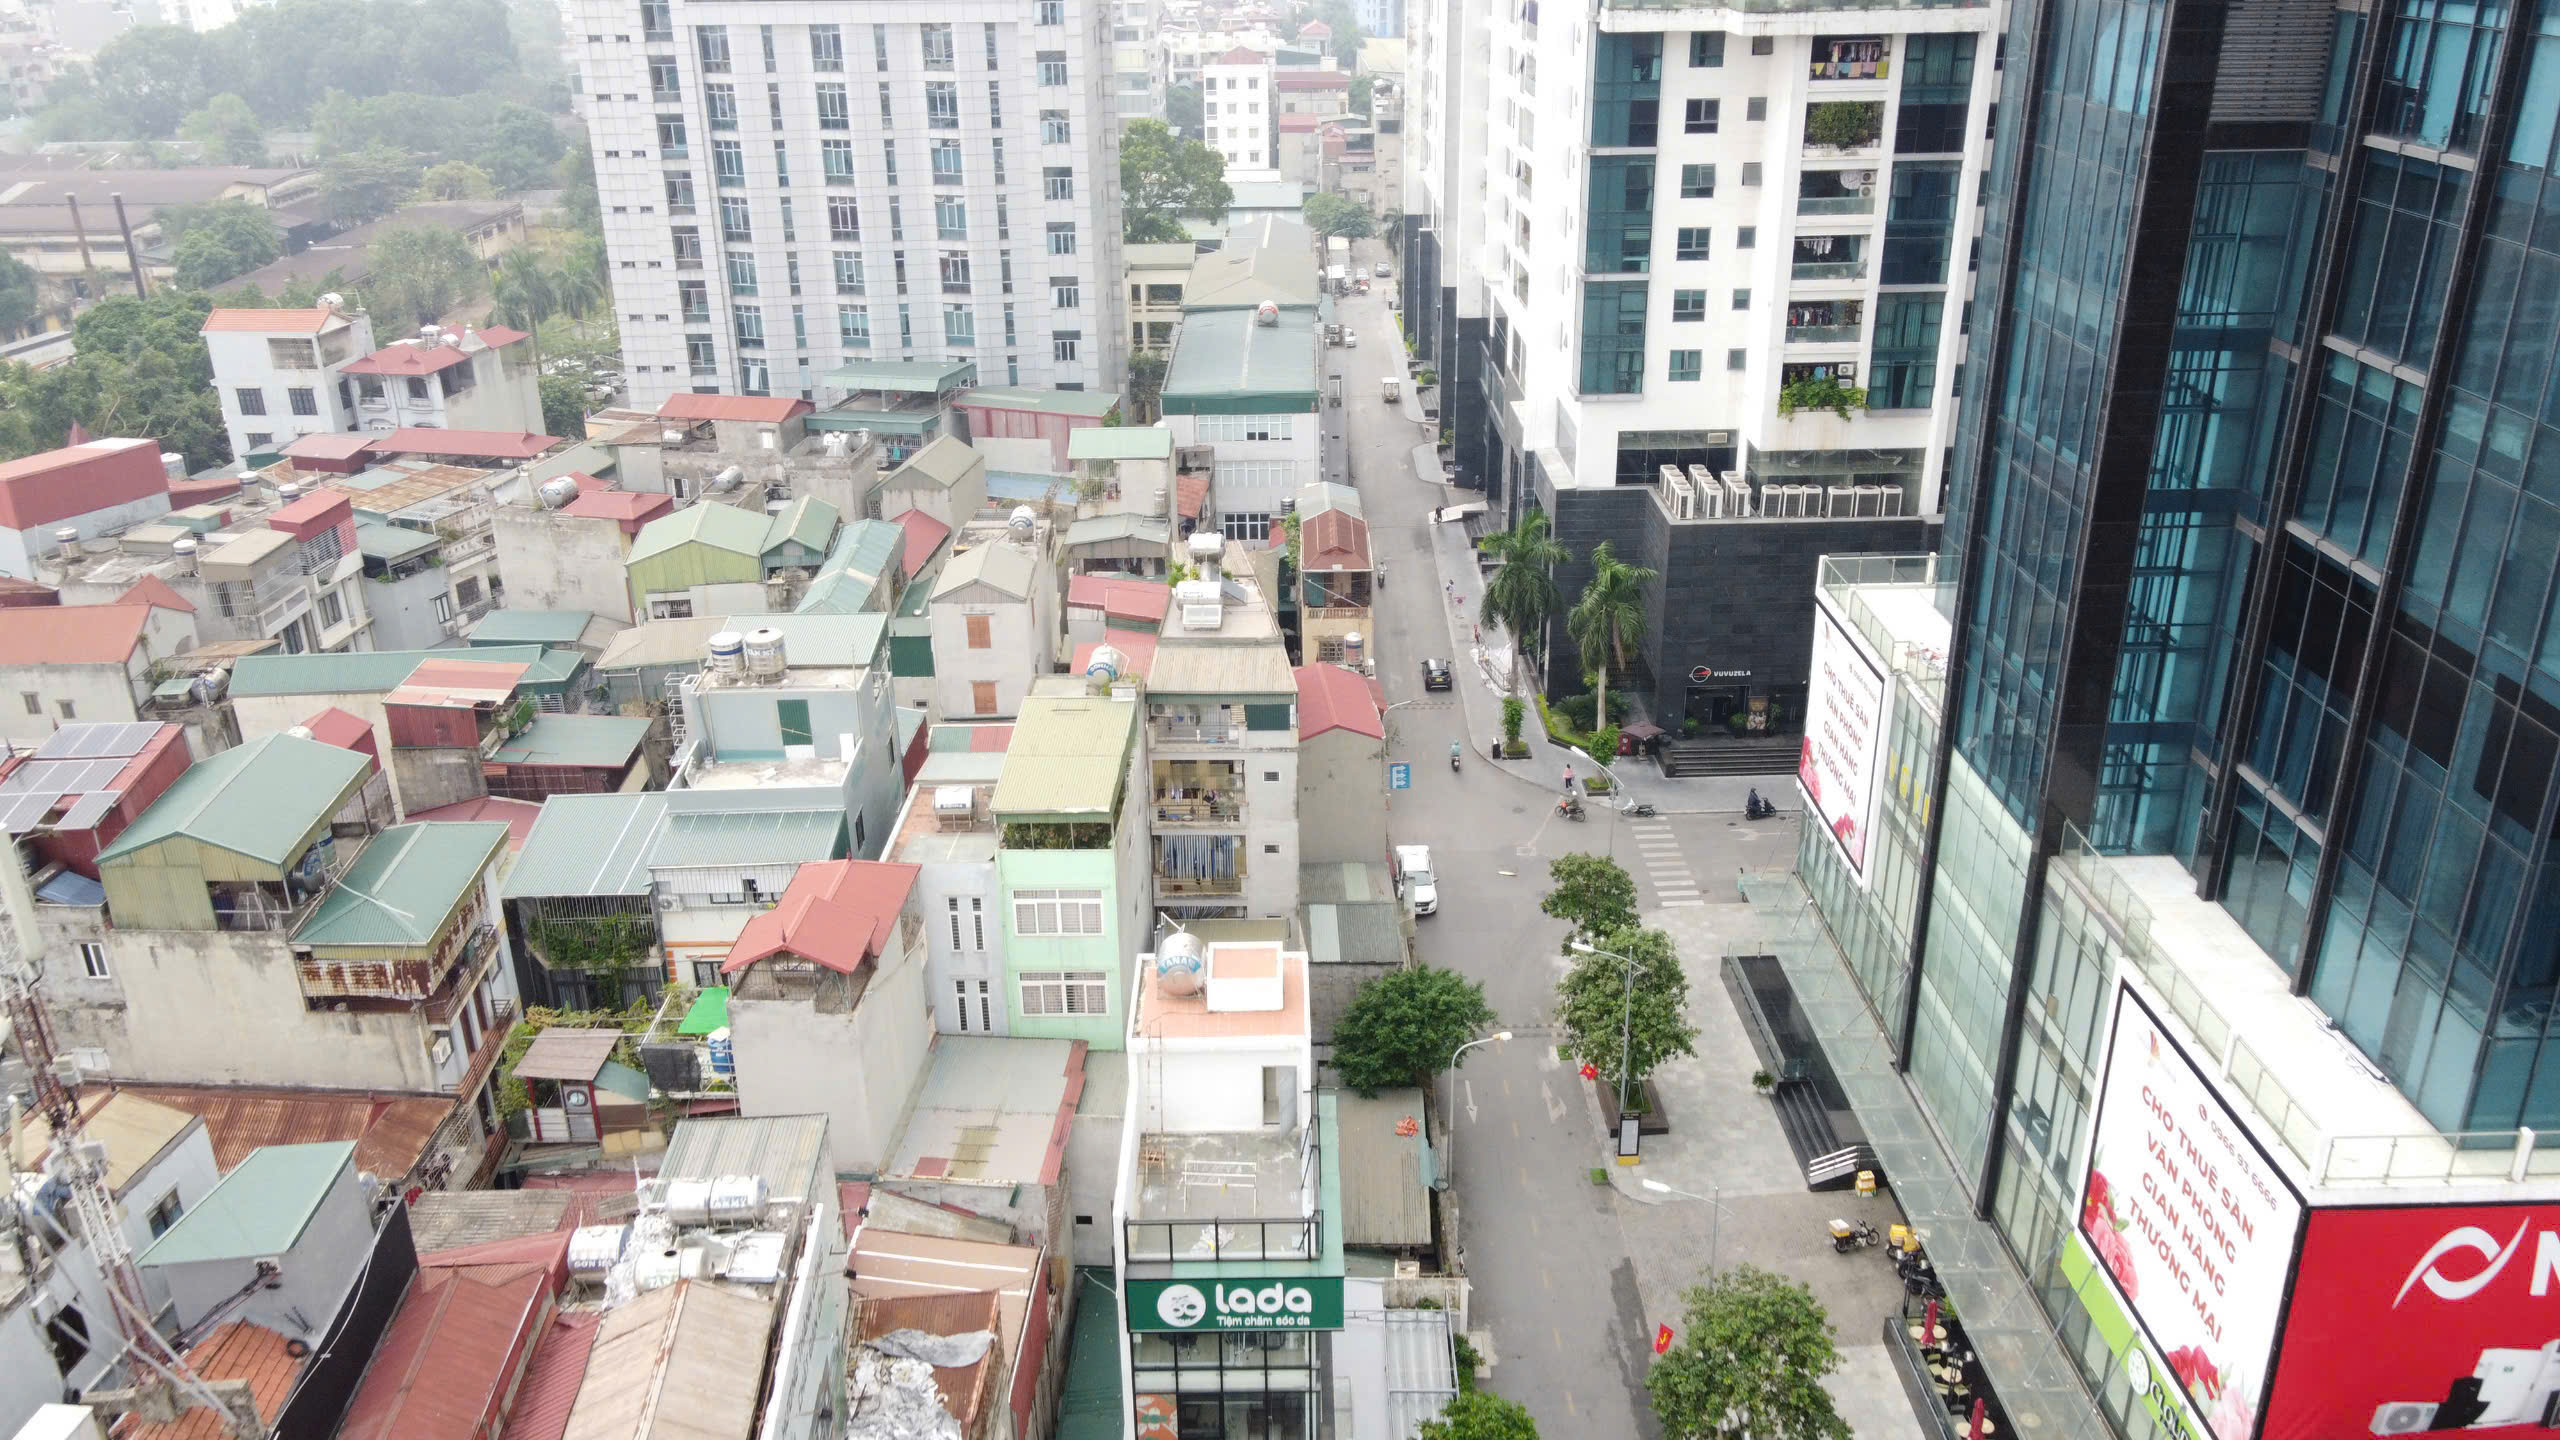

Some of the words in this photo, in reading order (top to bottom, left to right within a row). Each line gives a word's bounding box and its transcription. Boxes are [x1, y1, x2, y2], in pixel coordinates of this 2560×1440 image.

[1823, 661, 1837, 686] CHO
[1823, 720, 1839, 751] GIAN
[2142, 1085, 2174, 1132] CHO
[2178, 1127, 2218, 1193] THUÊ
[2221, 1187, 2254, 1242] SÀN
[2147, 1130, 2179, 1184] VĂN
[2182, 1177, 2236, 1264] PHÒNG
[2211, 1120, 2235, 1157] 0966
[2237, 1153, 2249, 1174] 93
[2251, 1172, 2277, 1211] 6666
[2130, 1196, 2191, 1294] THƯƠNG
[2192, 1289, 2222, 1343] MẠI
[2142, 1172, 2179, 1230] GIAN
[2182, 1224, 2226, 1296] HÀNG
[1216, 1282, 1312, 1314] lada
[1216, 1315, 1242, 1328] Tiệm
[1244, 1314, 1272, 1326] chăm
[1276, 1314, 1295, 1326] sóc
[1297, 1314, 1310, 1326] da
